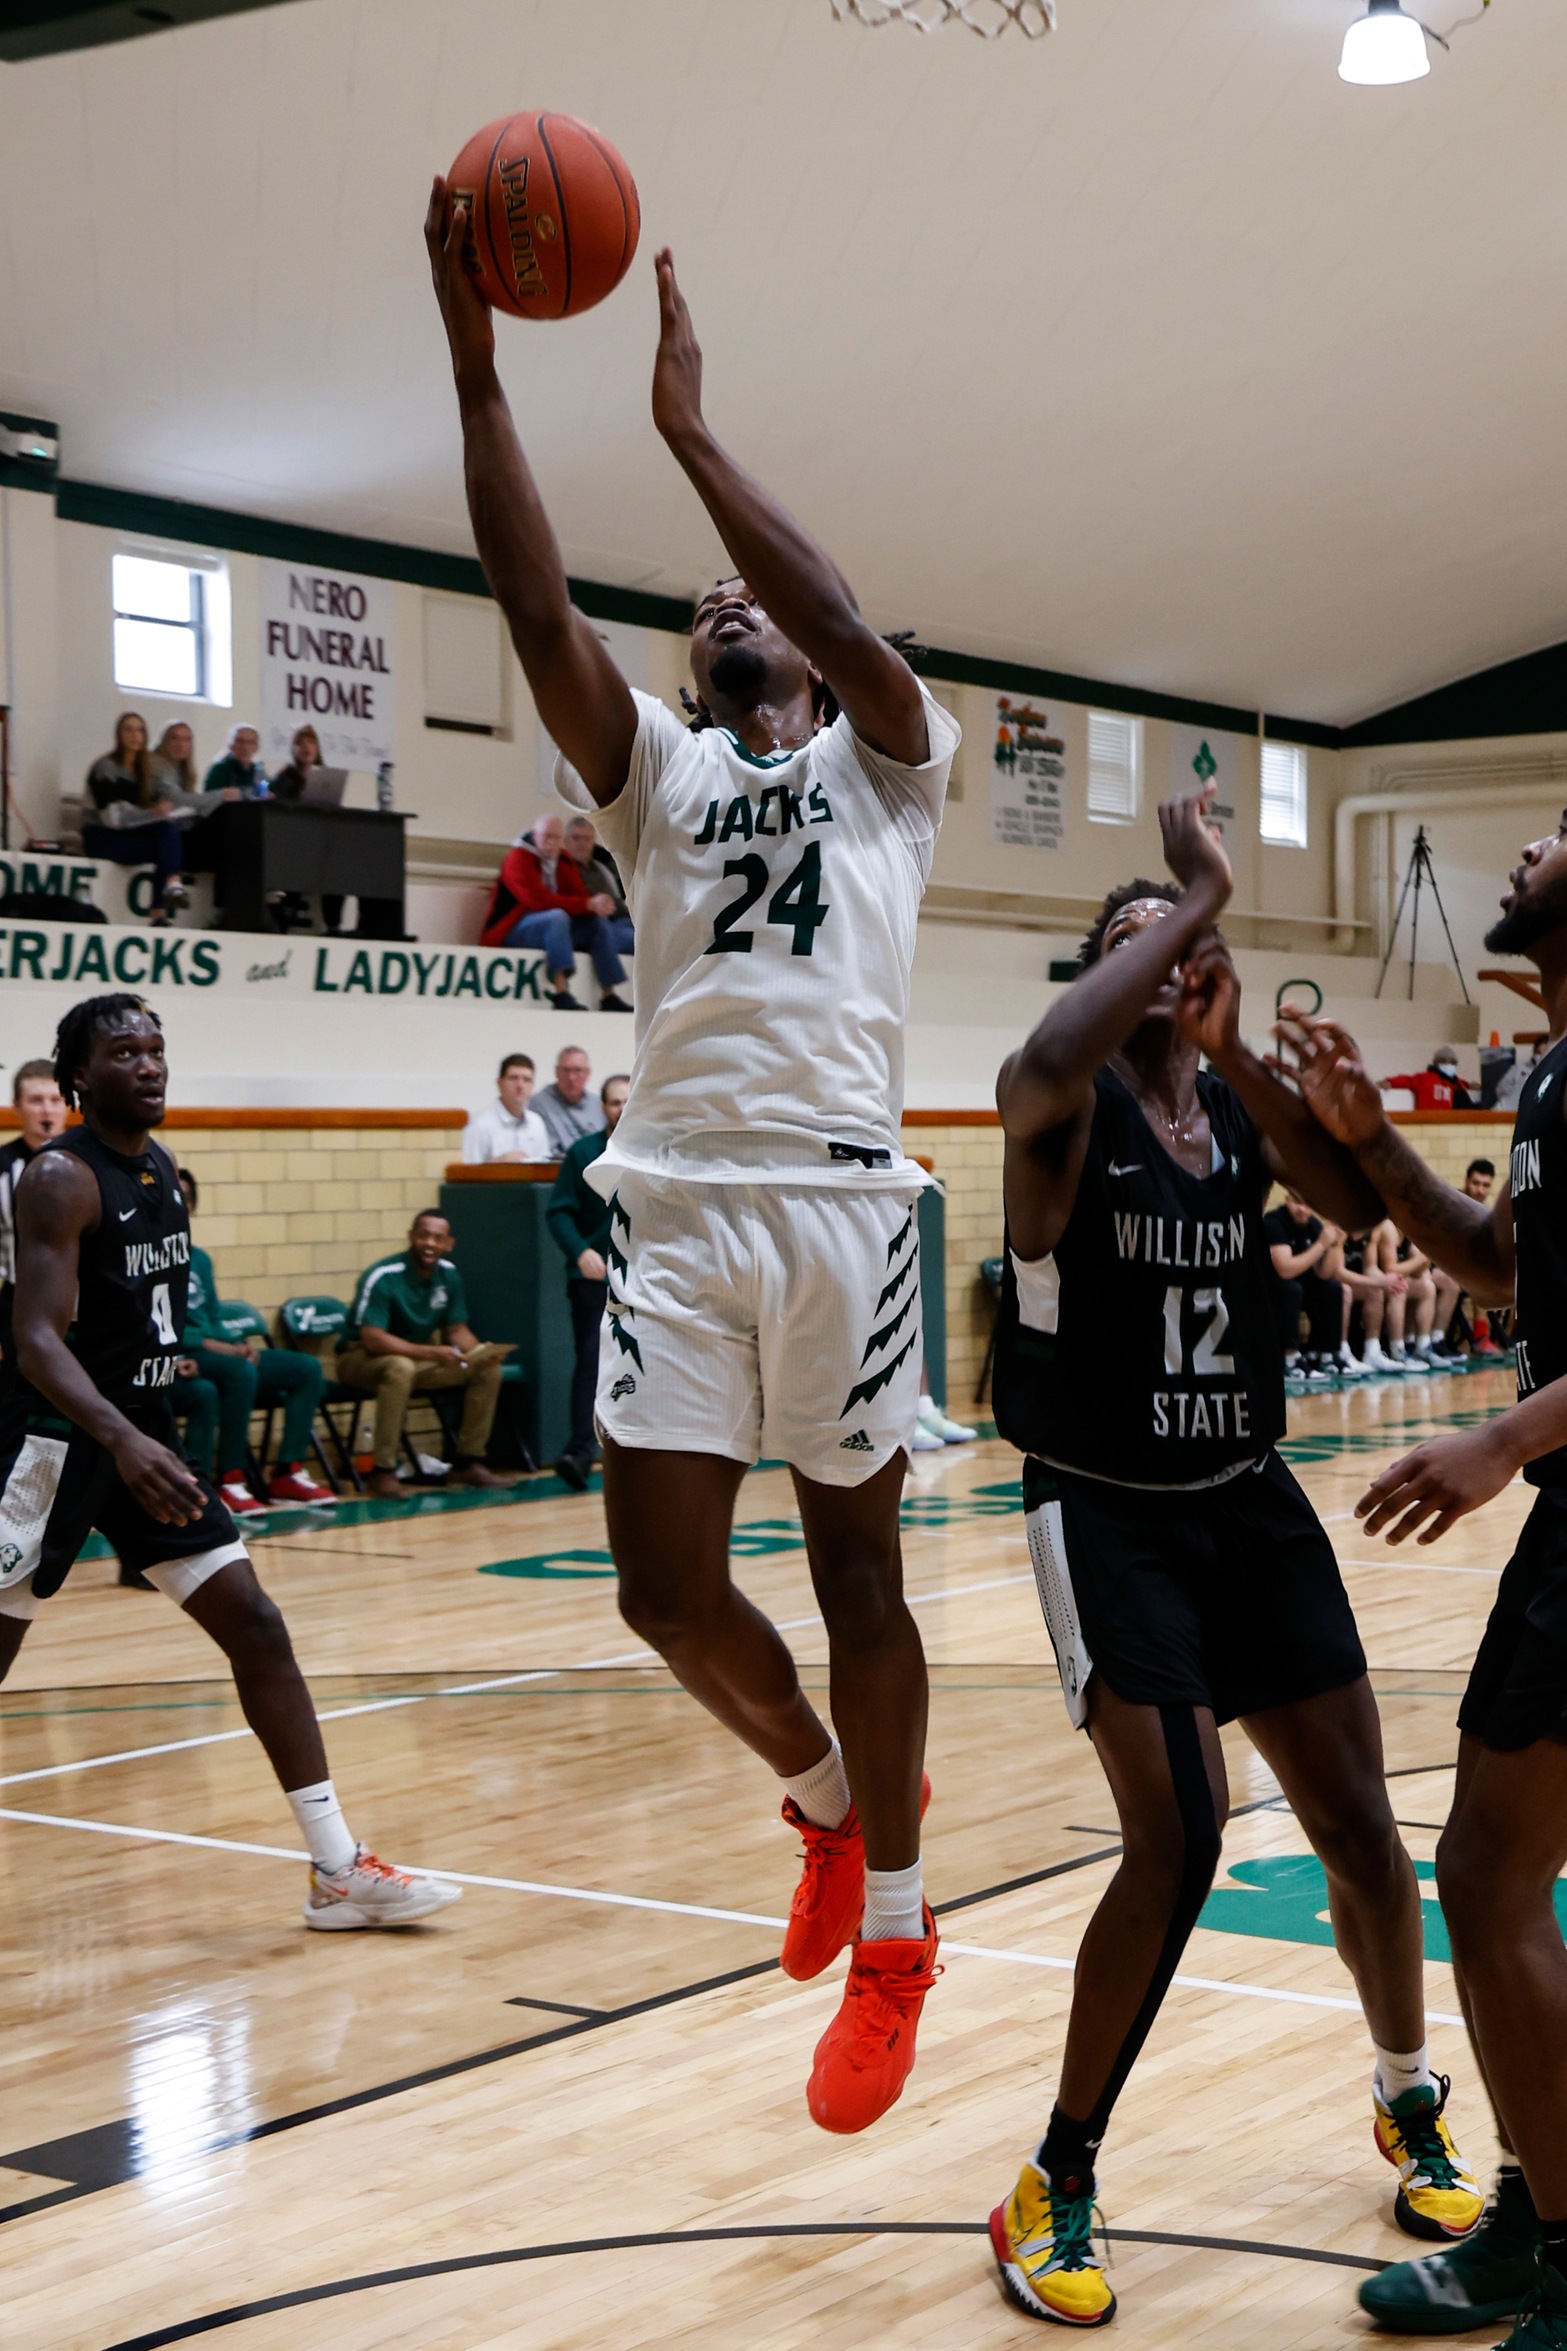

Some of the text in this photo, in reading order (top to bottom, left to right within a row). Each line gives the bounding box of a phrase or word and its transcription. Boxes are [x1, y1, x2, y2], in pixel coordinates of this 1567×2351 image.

[498, 156, 549, 296] SPALDING
[289, 572, 367, 622] NERO
[266, 619, 391, 674] FUNERAL
[286, 672, 374, 720] HOME
[694, 782, 834, 845] JACKS
[703, 840, 830, 956] 24
[246, 949, 292, 983] and
[313, 948, 554, 1000] LADYJACK
[1162, 1285, 1236, 1375] 12
[1152, 1391, 1250, 1438] STATE
